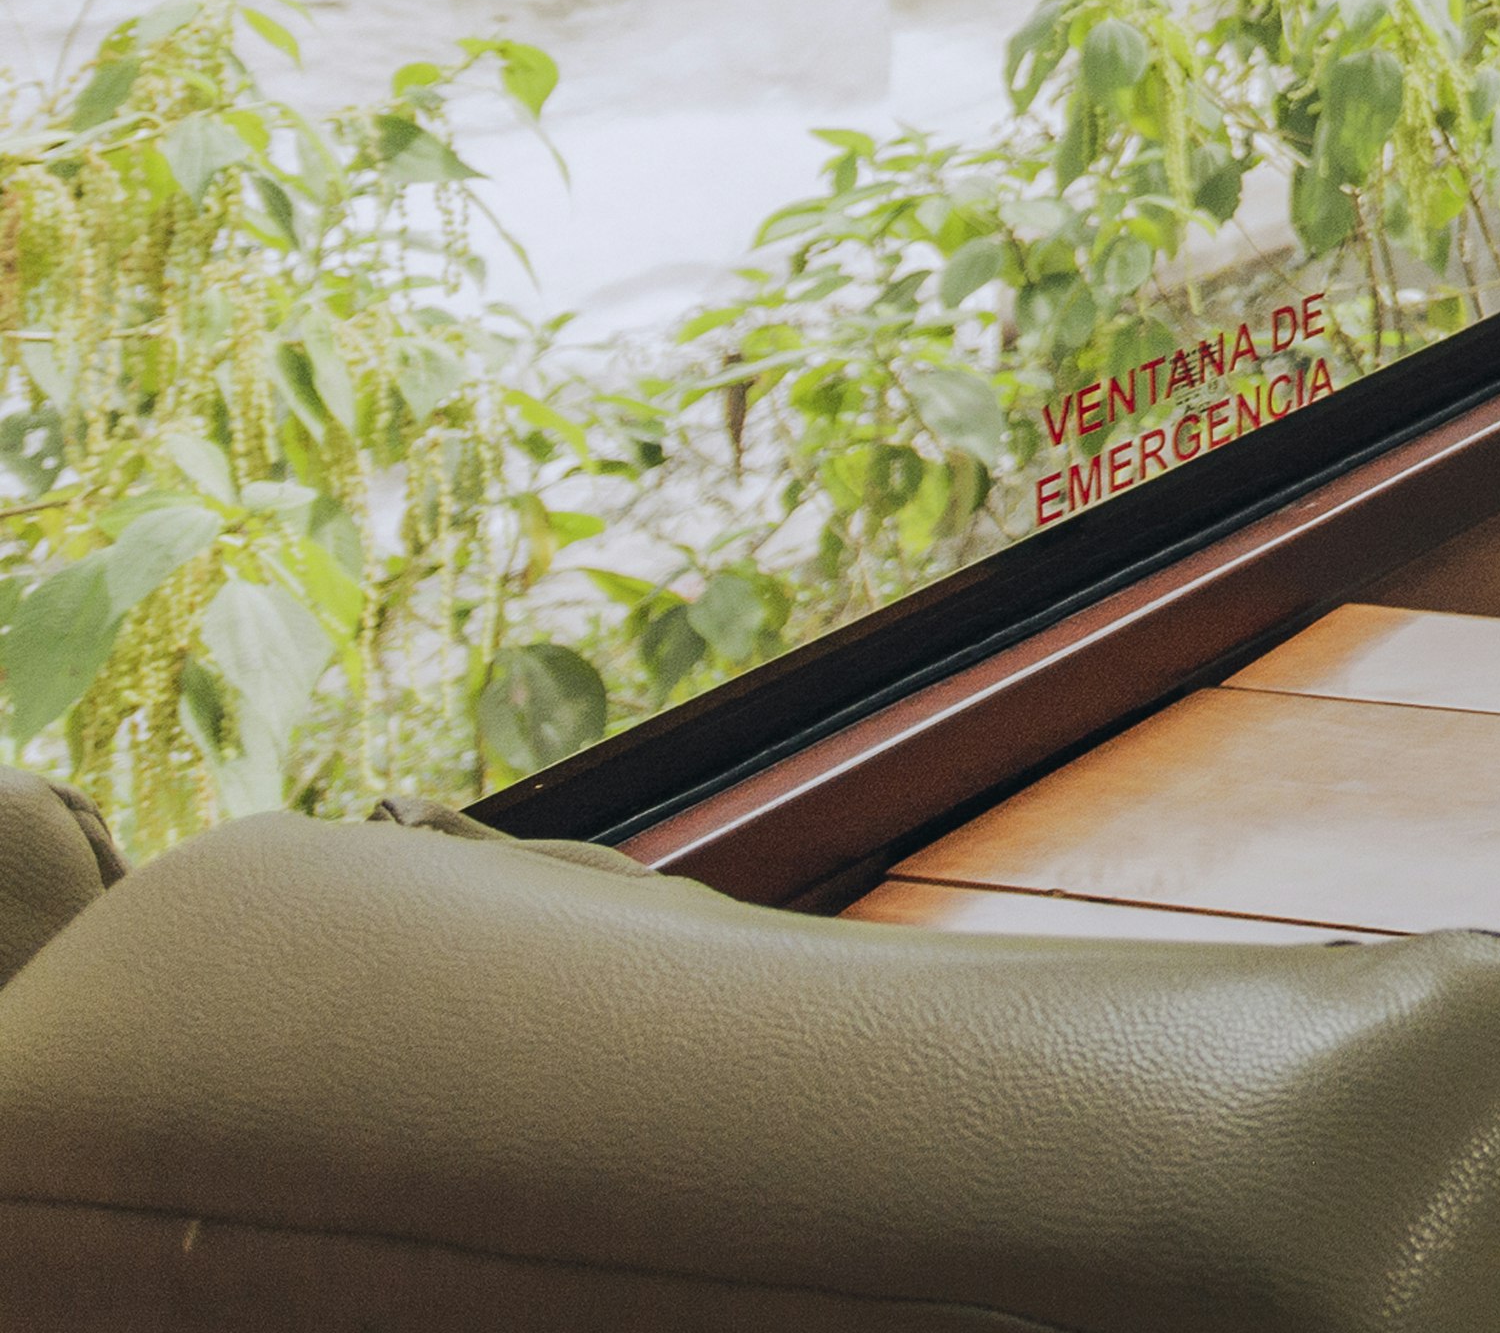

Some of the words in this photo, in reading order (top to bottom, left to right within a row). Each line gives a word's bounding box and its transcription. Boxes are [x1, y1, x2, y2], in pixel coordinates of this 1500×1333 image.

[1036, 357, 1335, 527] EMERGENCIA
[1042, 323, 1259, 447] VENTANA
[1271, 292, 1326, 353] DE
